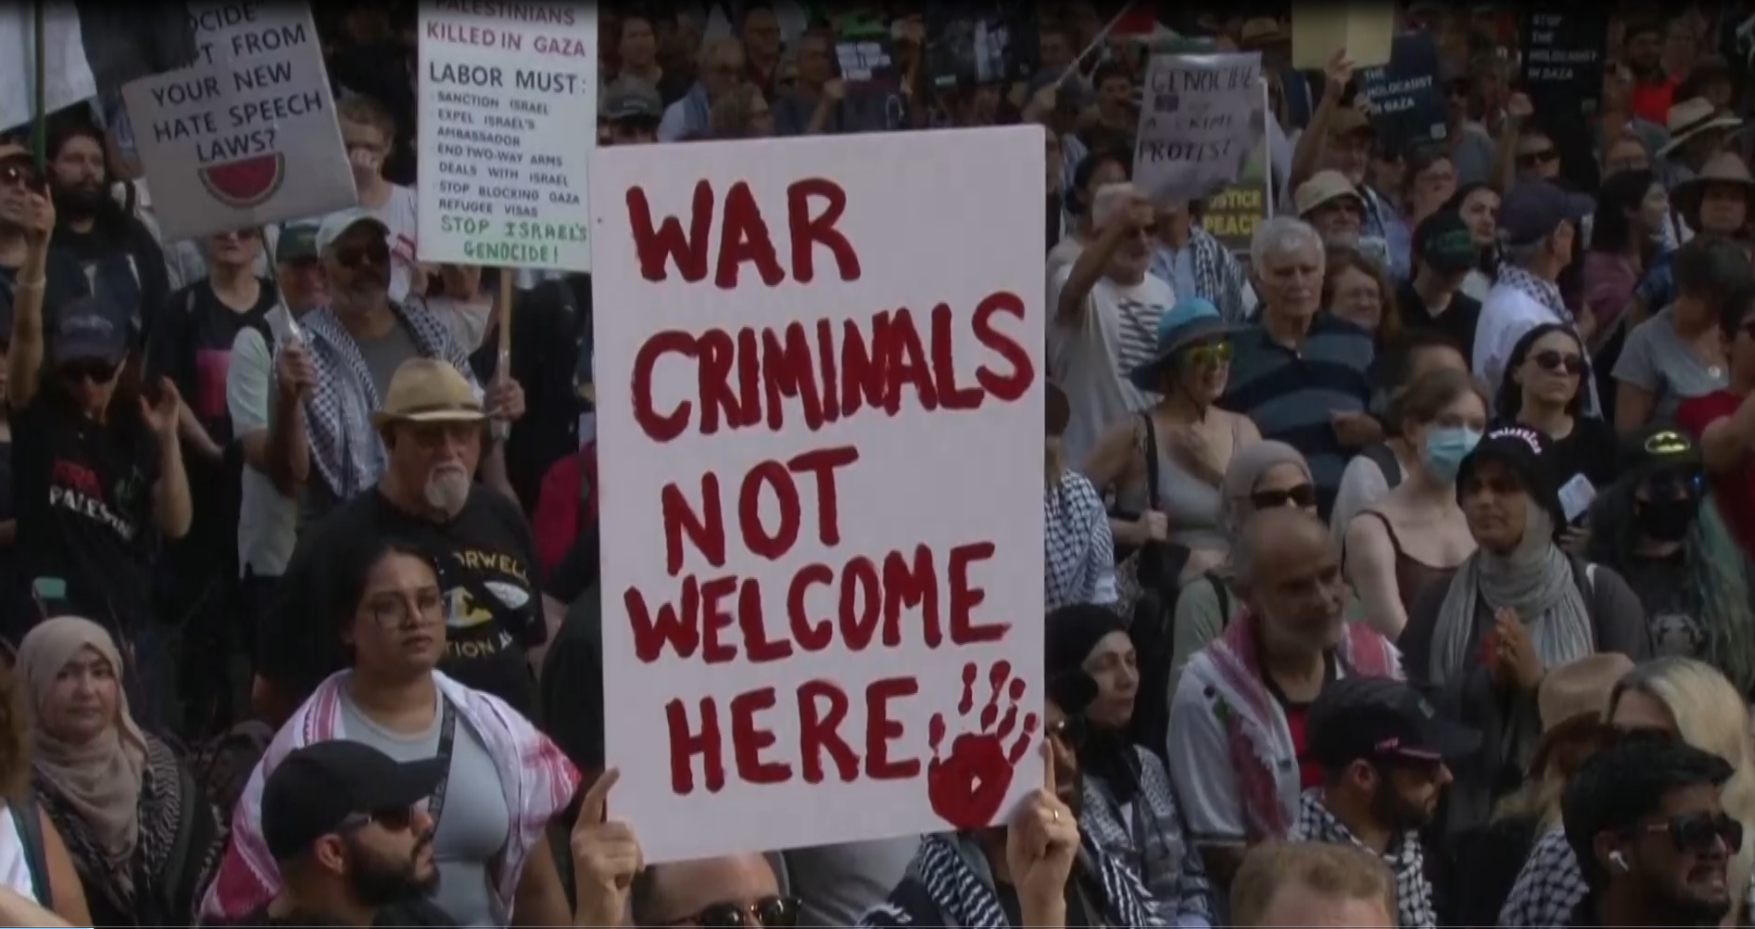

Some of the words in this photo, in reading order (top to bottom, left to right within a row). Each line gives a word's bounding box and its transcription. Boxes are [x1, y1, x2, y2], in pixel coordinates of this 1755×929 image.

[231, 23, 307, 57] FROM
[426, 20, 496, 47] KILLED
[501, 32, 522, 50] IN
[533, 35, 587, 58] GAZA
[151, 77, 221, 108] YOUR
[233, 61, 293, 93] NEW
[430, 61, 504, 88] LABOR
[153, 111, 218, 143] HATE
[228, 91, 323, 128] SPEECH
[437, 91, 500, 108] SANCTION
[509, 99, 550, 115] ISRAEL
[438, 108, 474, 124] EXPEL
[484, 115, 535, 130] ISRAEL'S
[197, 129, 276, 163] LAWS?
[437, 127, 521, 147] AMBASSADOR
[437, 144, 464, 157] END
[466, 147, 523, 165] TWO-WAY
[530, 154, 563, 167] ARMS
[439, 162, 478, 177] DEALS
[488, 167, 519, 180] WITH
[529, 172, 568, 187] ISRAEL
[439, 182, 471, 195] STOP
[478, 186, 540, 201] BLOCKING
[549, 193, 581, 205] GAZA
[439, 199, 494, 215] REFUGEE
[504, 204, 539, 218] VISAS
[441, 215, 491, 234] STOP
[505, 221, 588, 242] ISRAEL'S
[626, 178, 861, 289] WAR
[463, 240, 559, 264] GENOCIDE!
[631, 291, 1035, 443] CRIMINALS
[661, 445, 860, 577] NOT
[624, 541, 1012, 664] WELCOME
[665, 676, 921, 796] HERE
